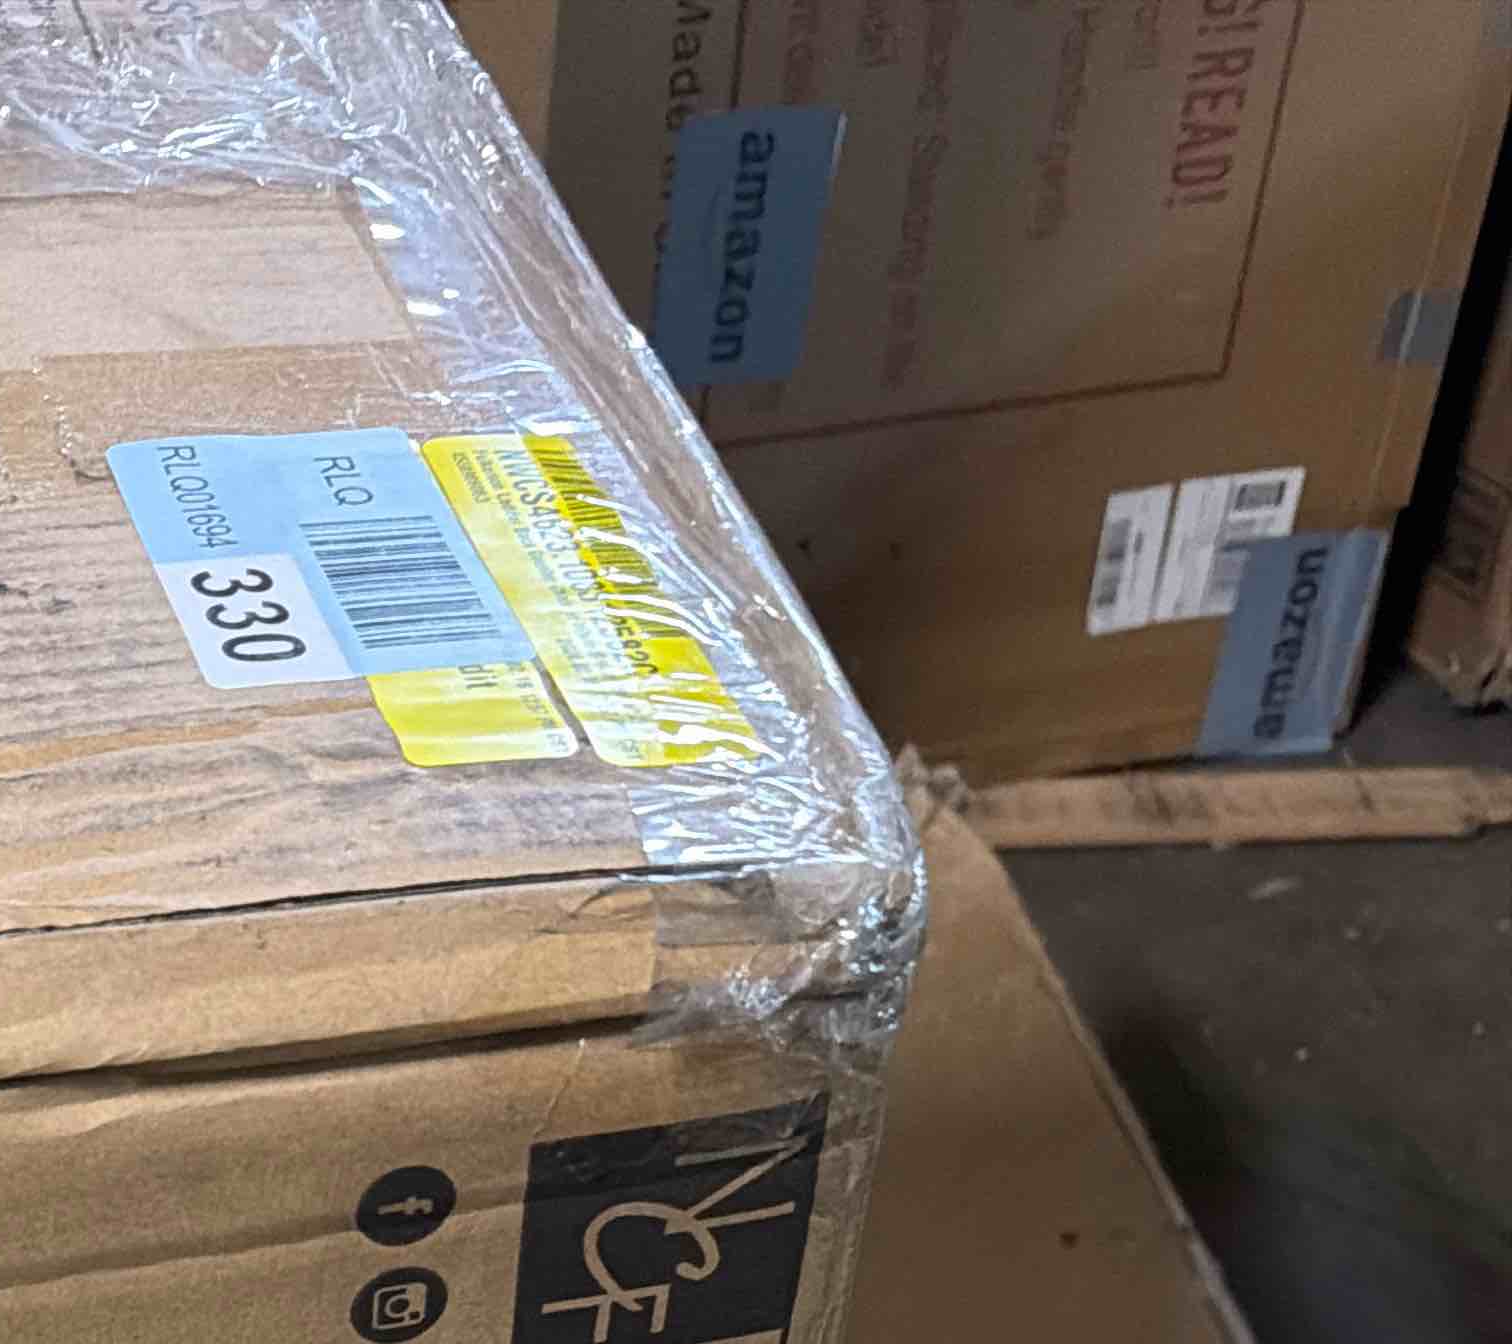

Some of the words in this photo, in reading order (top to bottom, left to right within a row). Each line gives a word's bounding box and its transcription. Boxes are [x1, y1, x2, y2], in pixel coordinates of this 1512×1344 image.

[1162, 48, 1254, 210] READ!
[708, 131, 775, 363] amazon
[157, 444, 237, 549] RLQ01694
[313, 455, 374, 507] RLQ
[190, 567, 306, 664] 330
[1253, 547, 1330, 738] amazon
